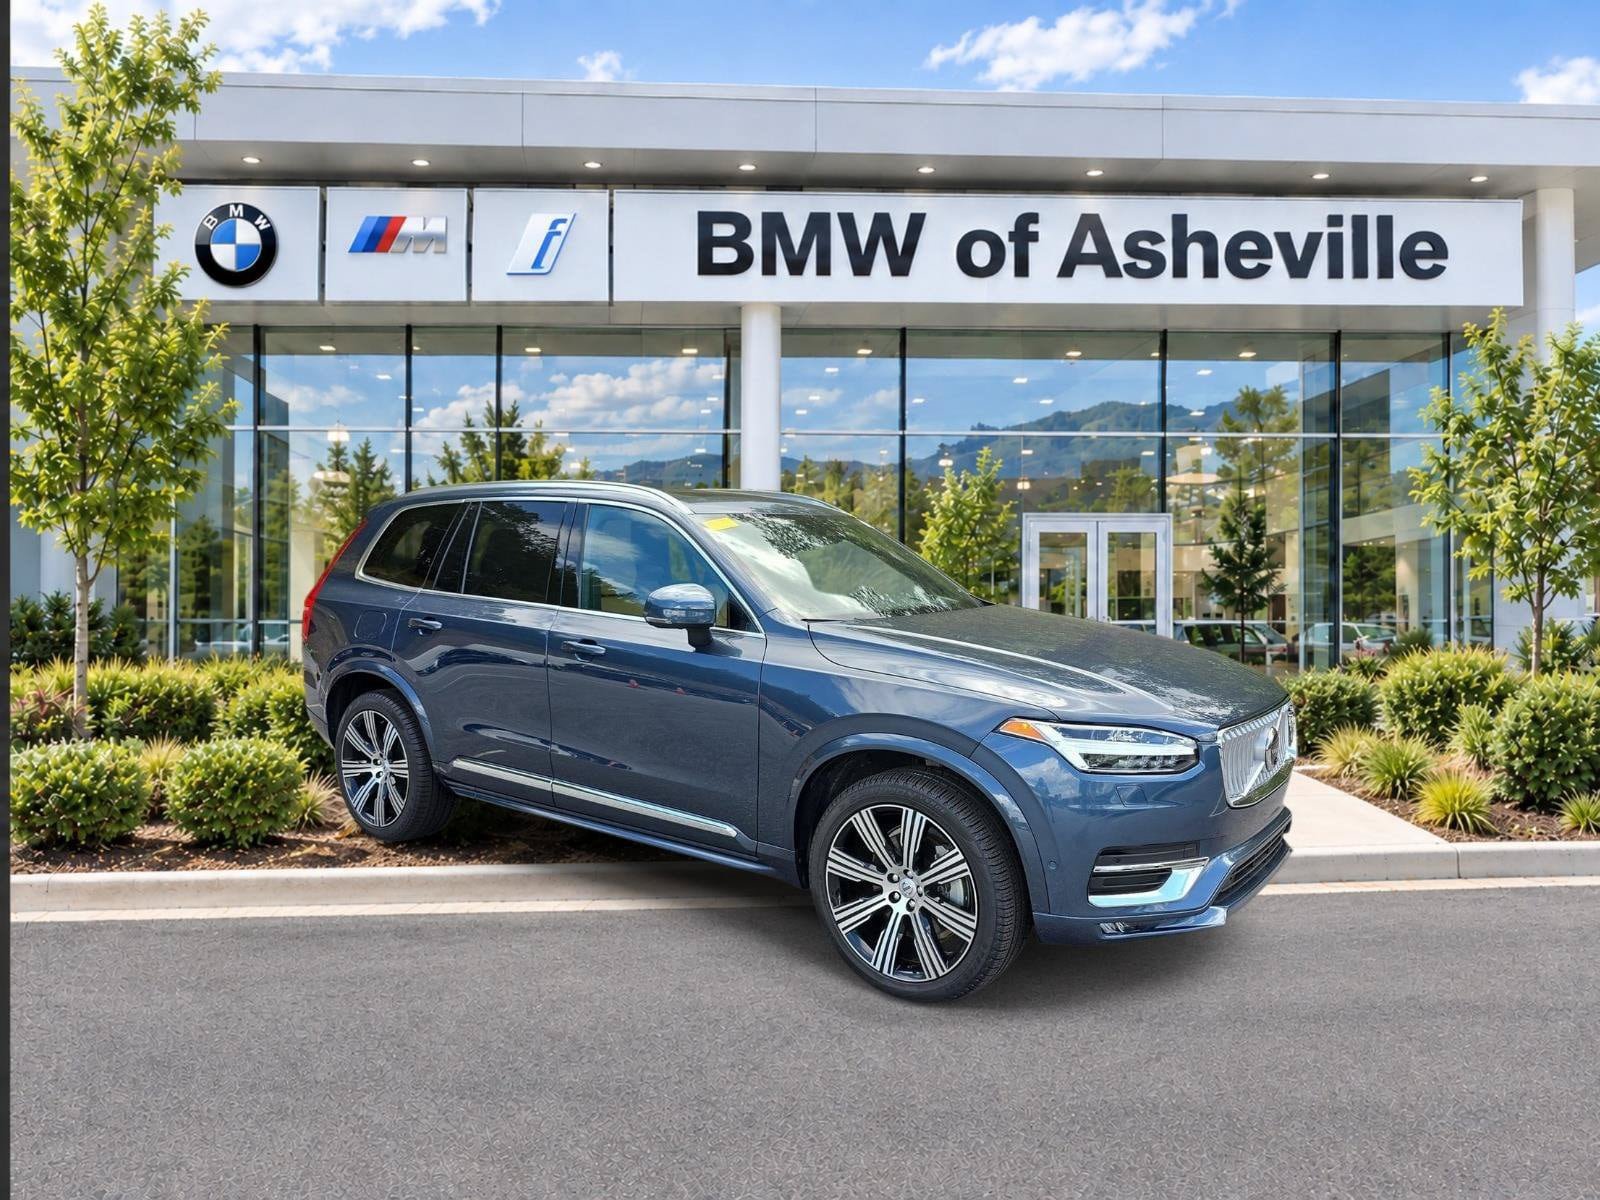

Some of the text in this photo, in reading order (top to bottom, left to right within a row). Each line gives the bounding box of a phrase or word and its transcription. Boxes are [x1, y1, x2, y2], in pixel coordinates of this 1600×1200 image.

[202, 203, 272, 231] BMW
[386, 215, 448, 255] M
[697, 210, 1449, 280] BMW of Asheville
